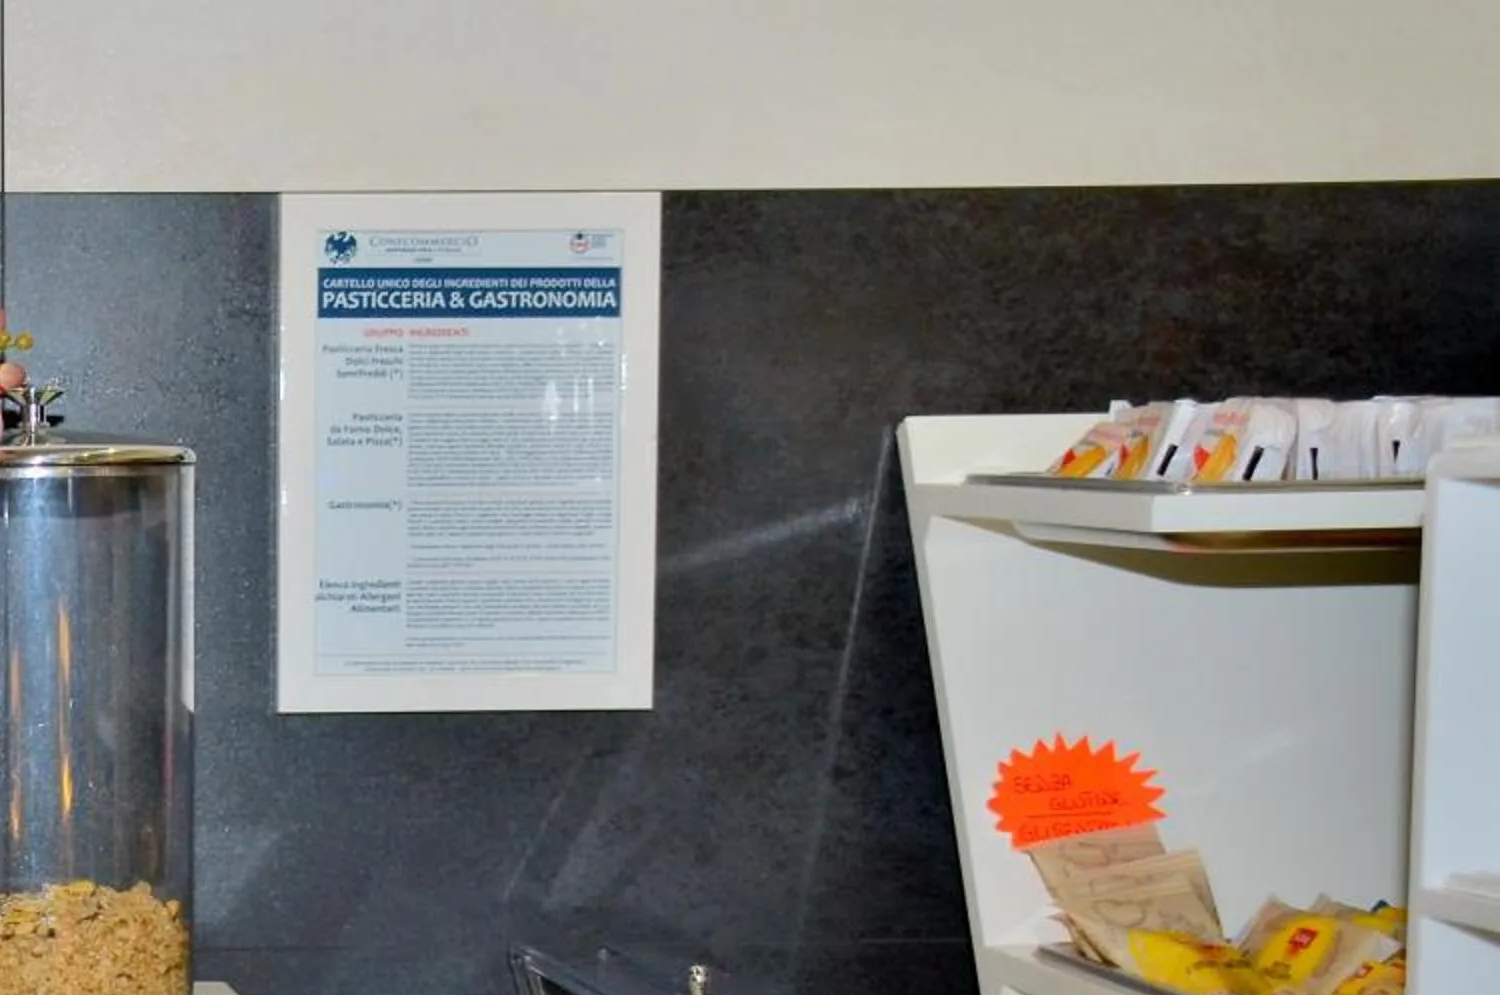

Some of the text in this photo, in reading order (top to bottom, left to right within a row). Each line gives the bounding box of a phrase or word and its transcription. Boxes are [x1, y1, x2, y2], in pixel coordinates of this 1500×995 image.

[323, 277, 616, 288] CARTELLO UNICO DEGLI INGREDIENTI DEI PRODOTTI DELLA
[323, 291, 617, 309] PASTICCERIA & GASTRONOMIA
